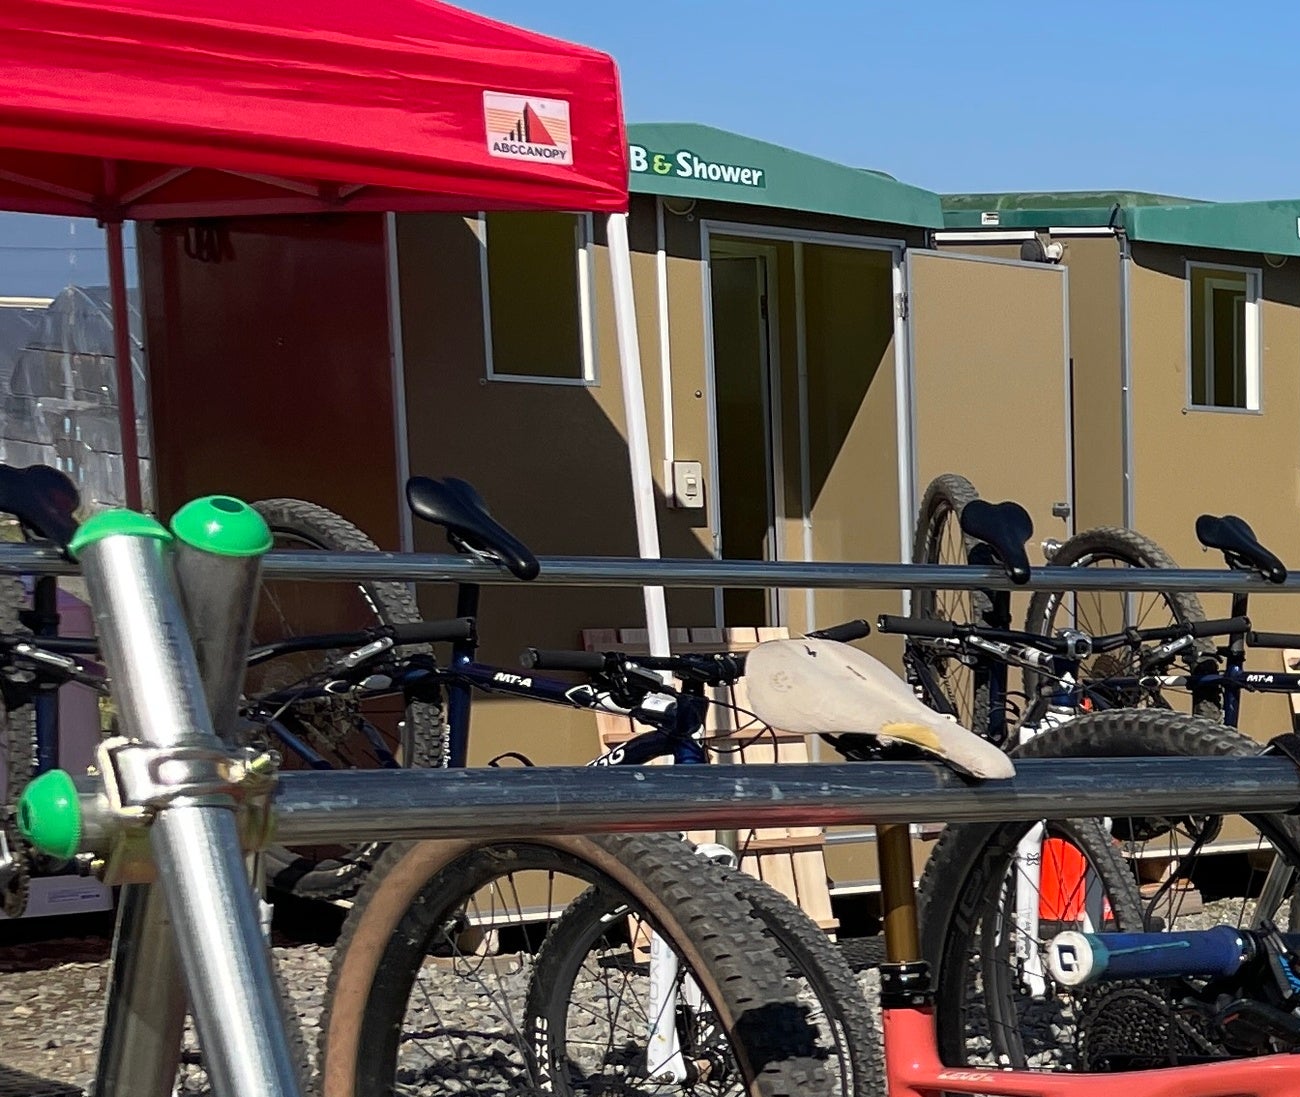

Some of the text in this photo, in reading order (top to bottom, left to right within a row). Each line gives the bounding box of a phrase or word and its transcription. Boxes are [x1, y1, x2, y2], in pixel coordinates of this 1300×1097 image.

[492, 142, 567, 161] ABCCANOPY
[629, 146, 762, 186] B & Shower
